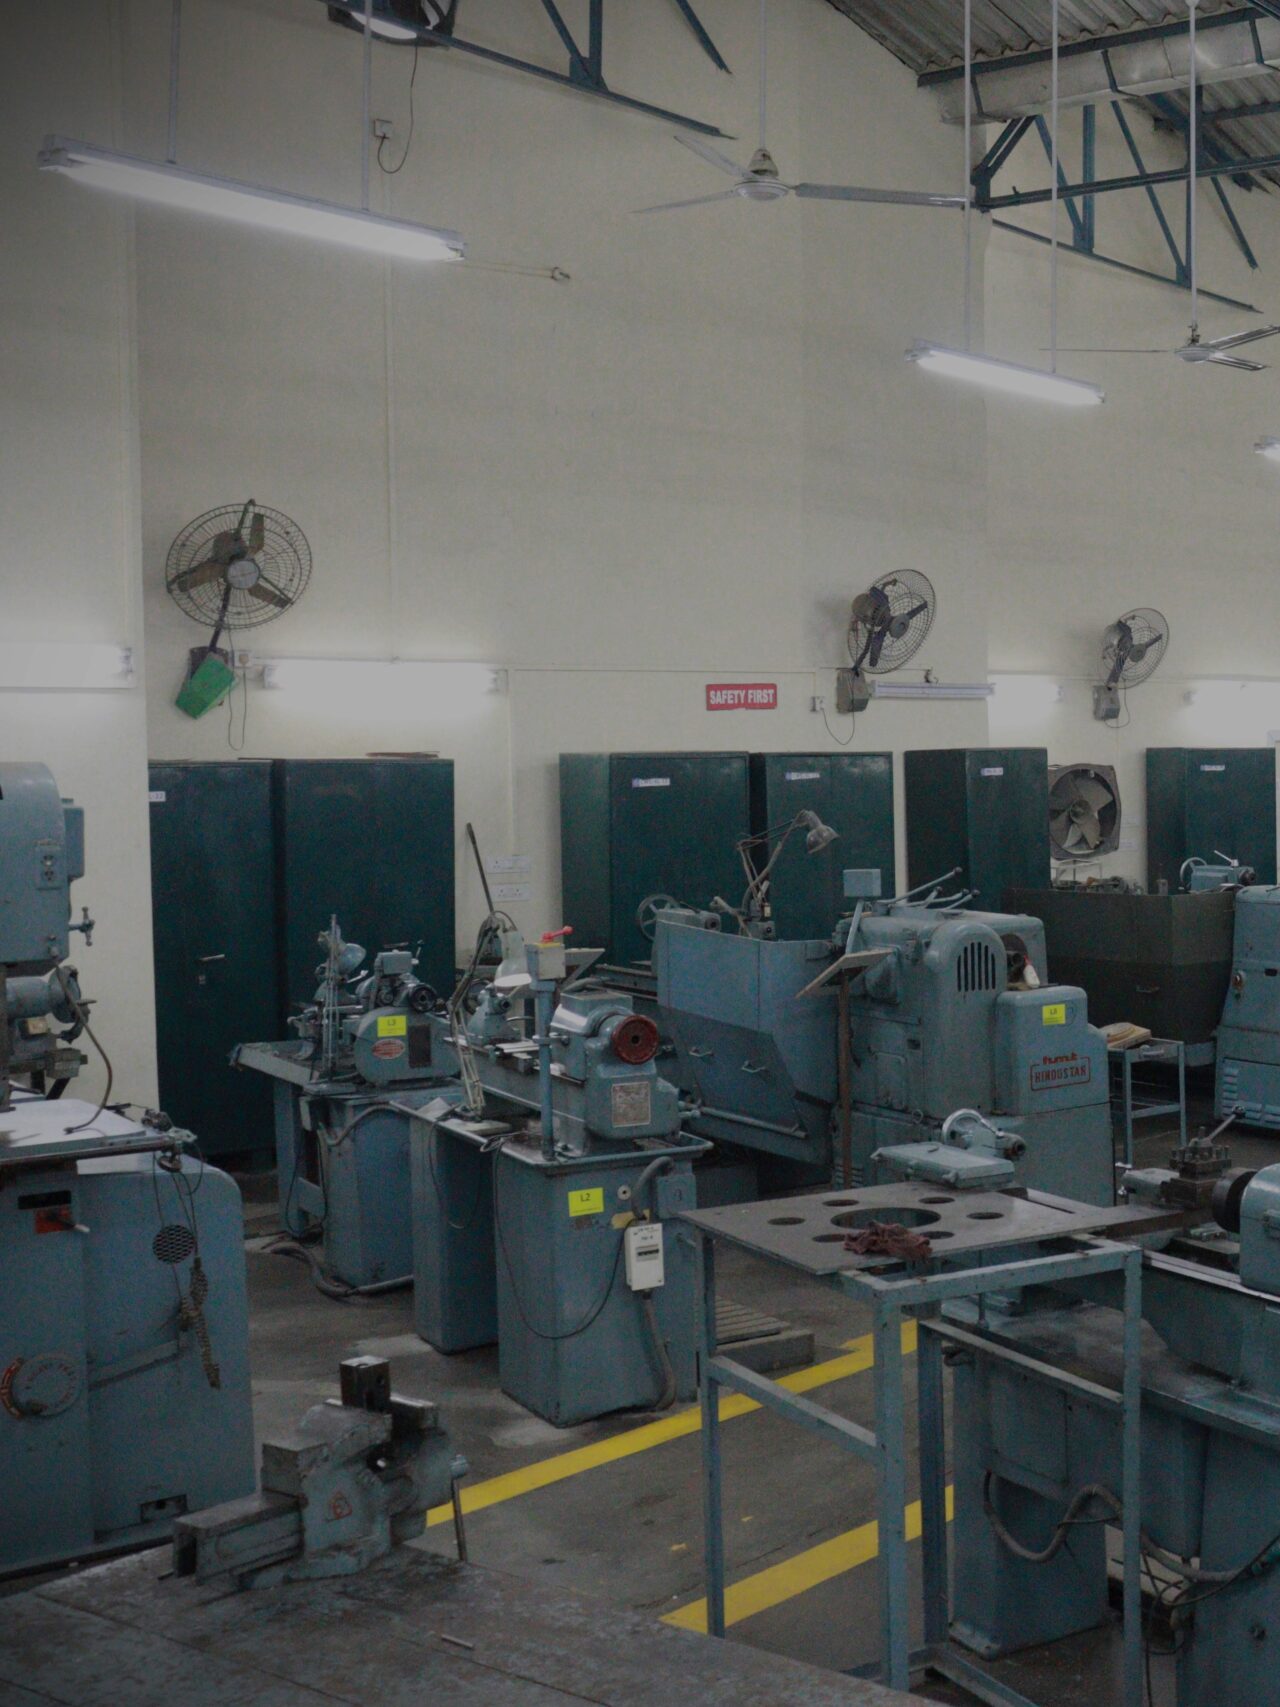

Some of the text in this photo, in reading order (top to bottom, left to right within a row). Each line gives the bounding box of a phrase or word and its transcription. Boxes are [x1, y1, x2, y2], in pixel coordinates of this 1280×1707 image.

[710, 688, 775, 705] SAFETY FIRST
[1035, 1065, 1087, 1084] HINDUSTAN
[580, 1192, 591, 1202] L2
